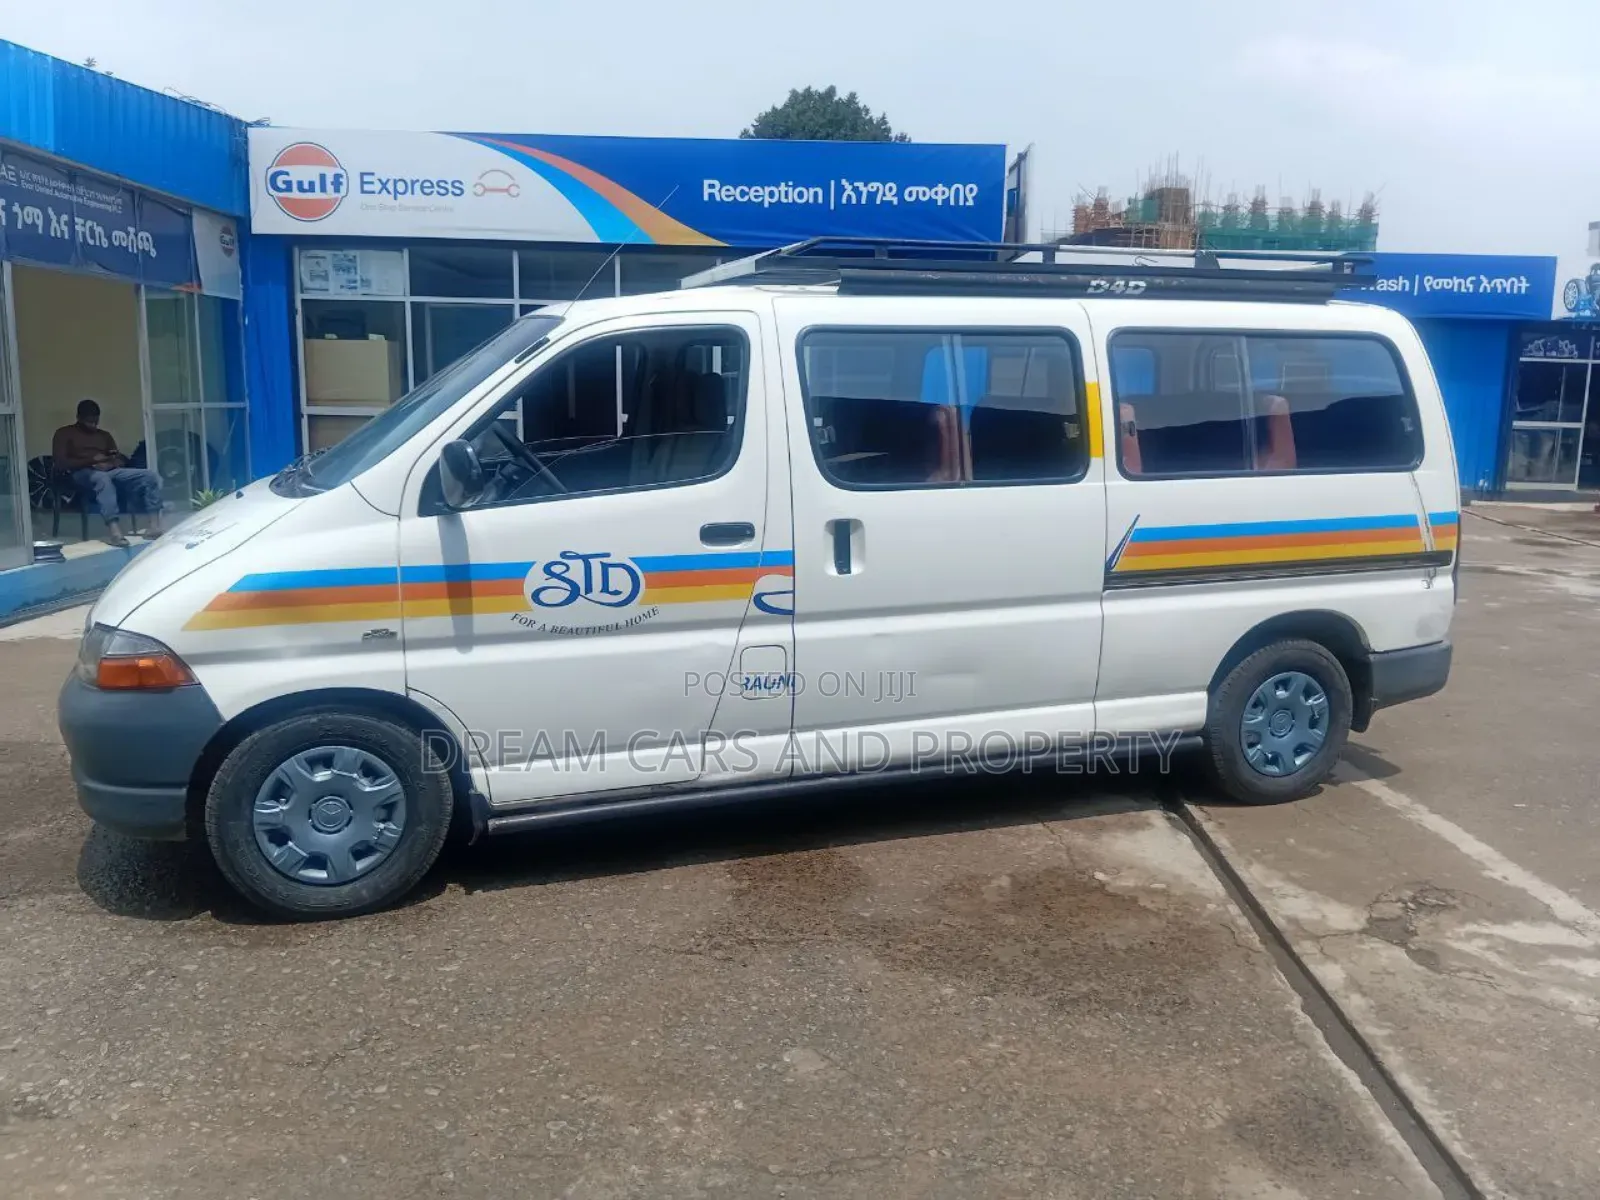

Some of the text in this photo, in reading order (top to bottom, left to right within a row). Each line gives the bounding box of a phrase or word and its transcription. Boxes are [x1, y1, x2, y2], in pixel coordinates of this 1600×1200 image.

[269, 170, 344, 193] Gulf
[359, 172, 465, 200] Express
[703, 179, 824, 208] Reception
[840, 178, 978, 206] እንግዳ መቀበያ
[531, 550, 641, 608] STD
[510, 605, 660, 635] FOR A BEAUTIFUL HOME
